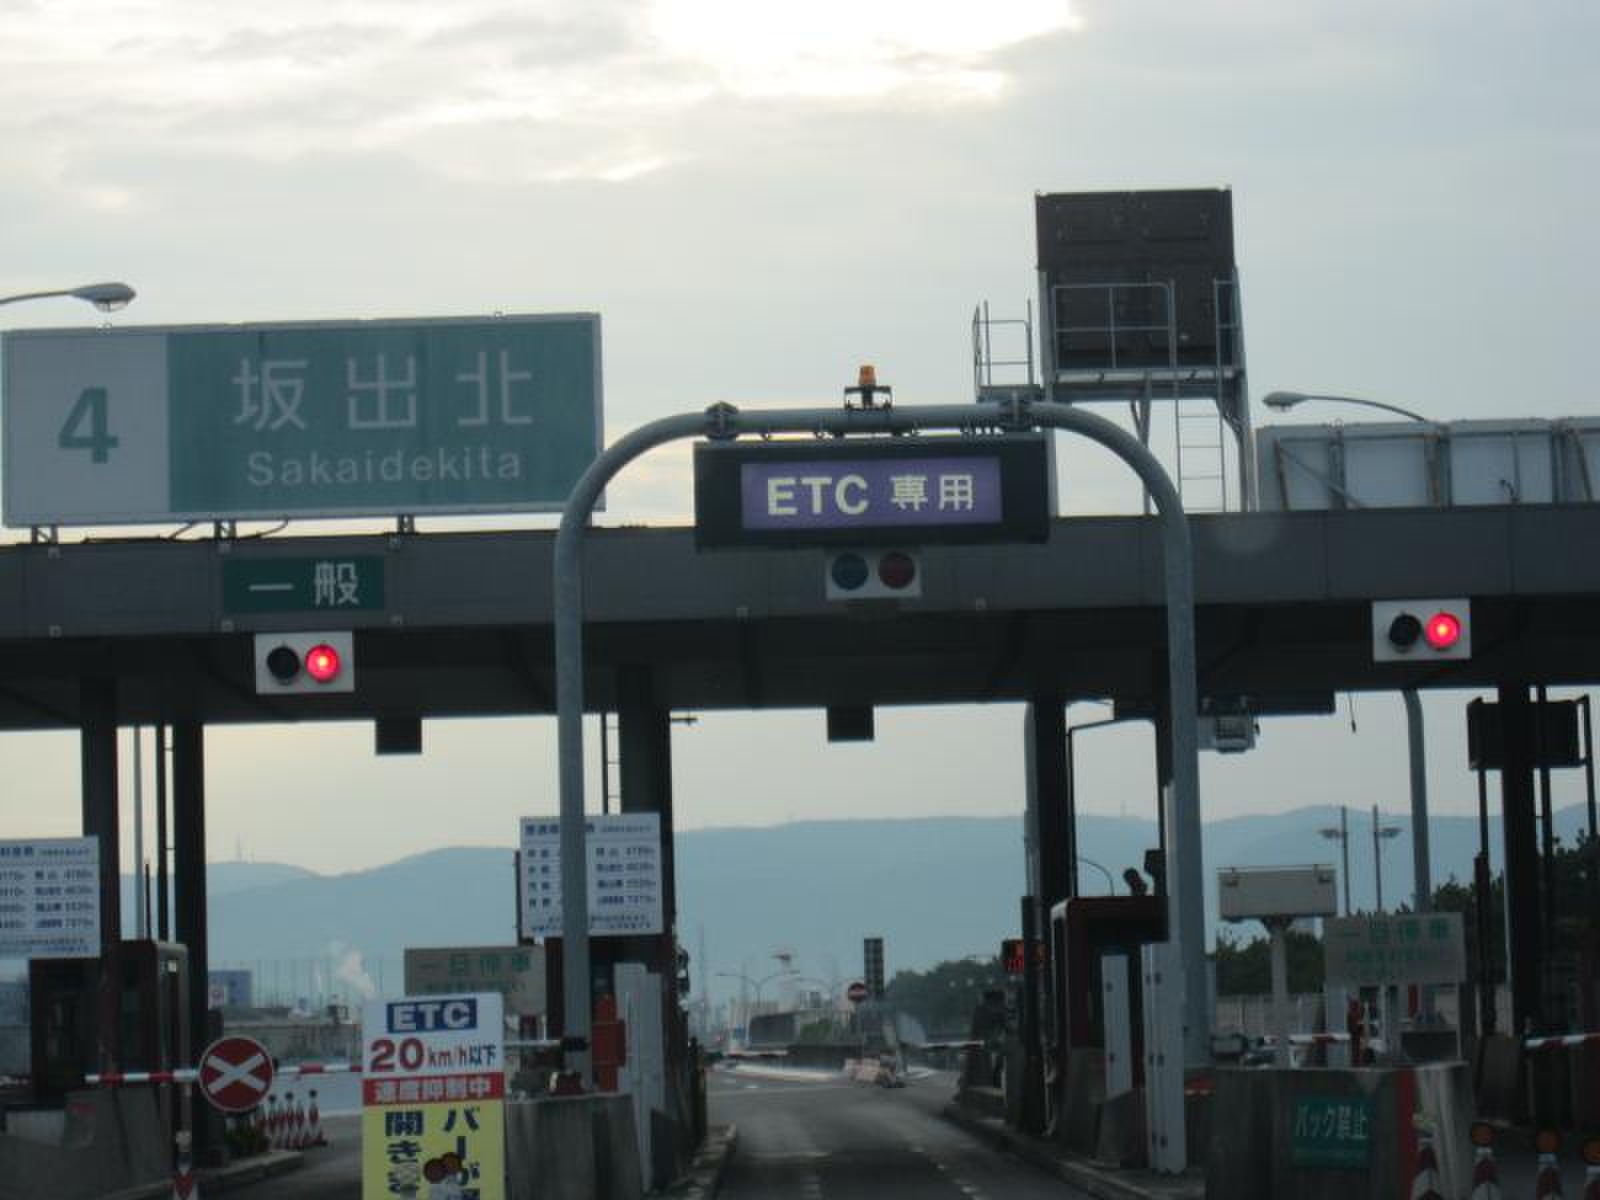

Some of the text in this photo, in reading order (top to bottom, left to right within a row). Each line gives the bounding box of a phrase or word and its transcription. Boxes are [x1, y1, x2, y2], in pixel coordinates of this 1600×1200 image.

[232, 350, 533, 430] 坂出北
[58, 386, 119, 464] 4
[247, 447, 521, 486] Sakaidekita
[767, 474, 974, 515] ETC 専用
[249, 562, 359, 605] 一般
[393, 1002, 471, 1032] ETC
